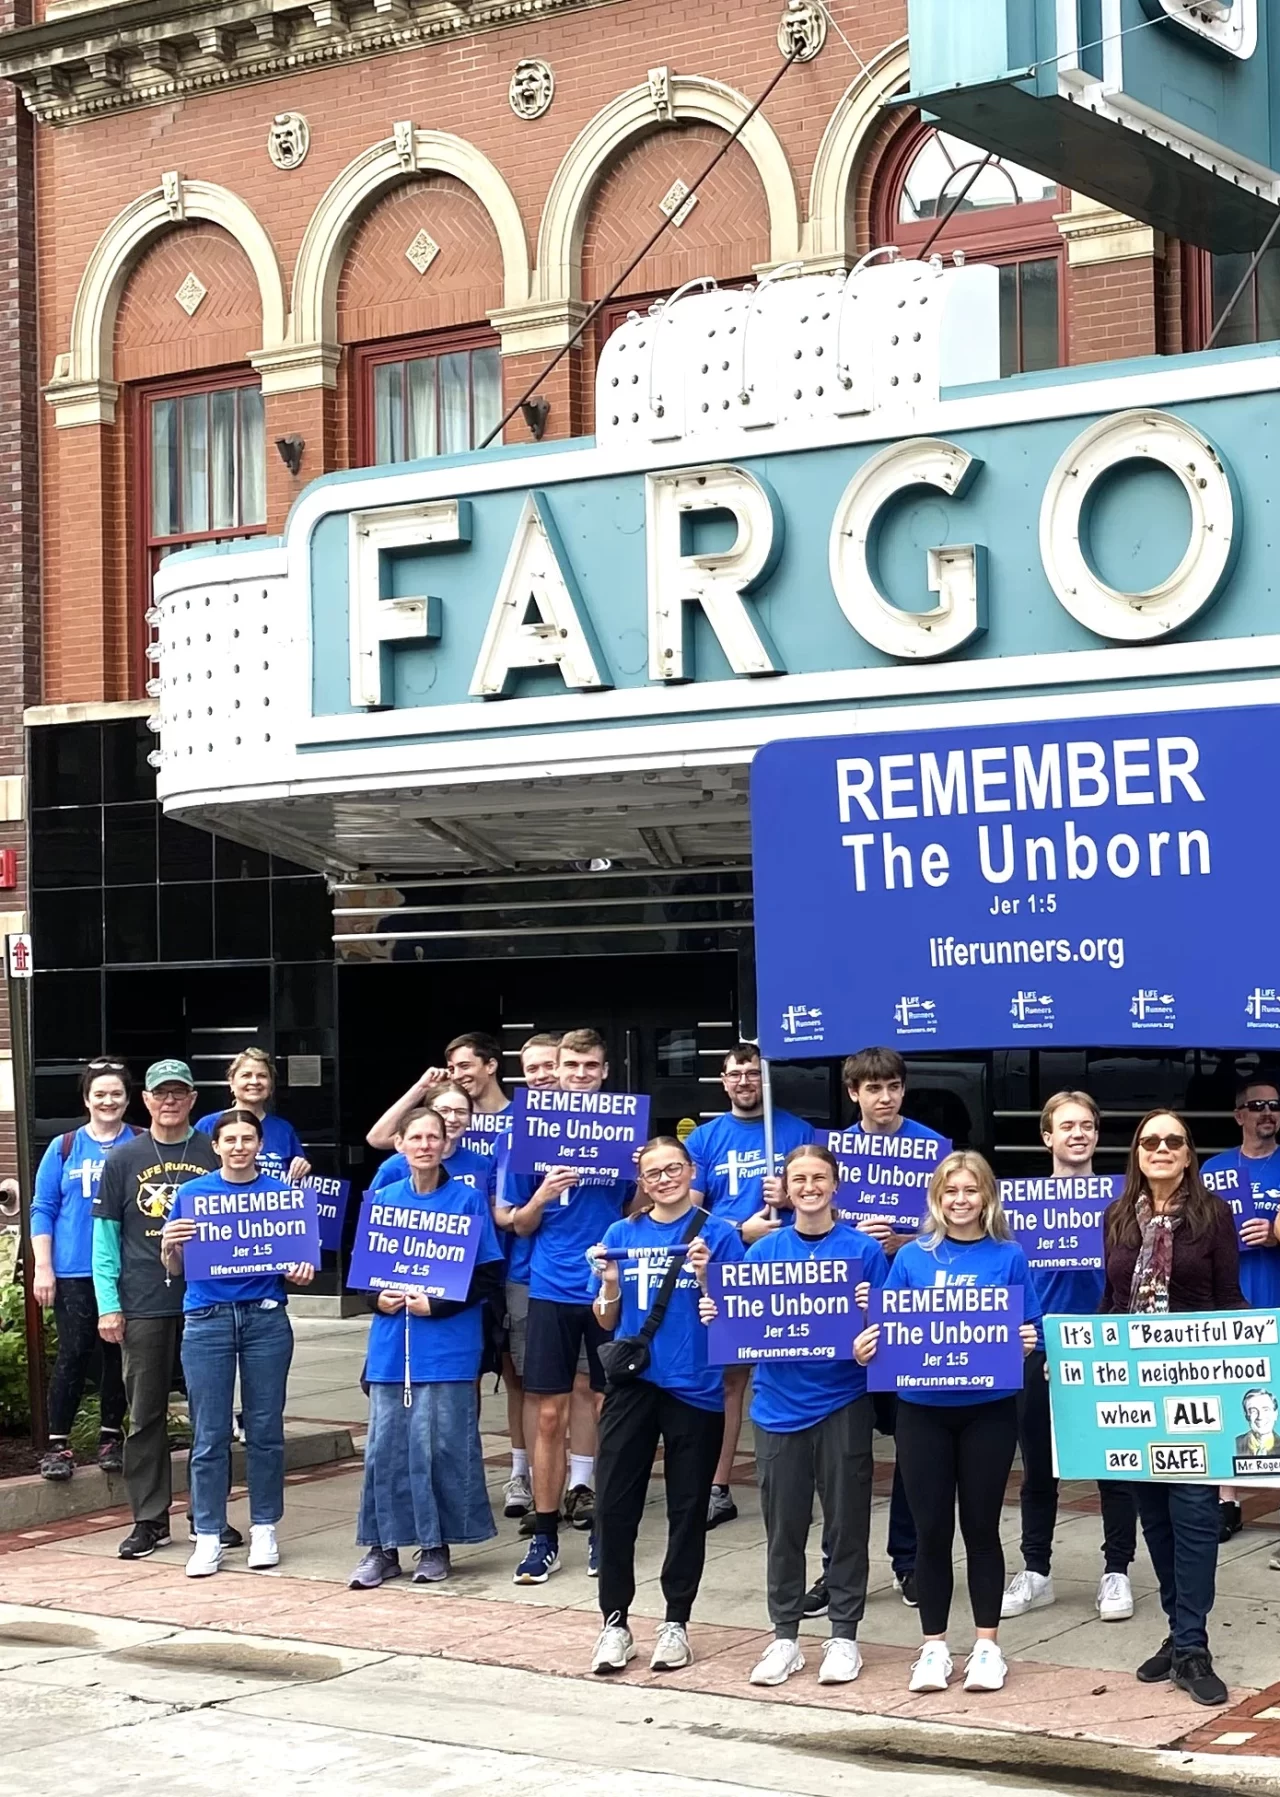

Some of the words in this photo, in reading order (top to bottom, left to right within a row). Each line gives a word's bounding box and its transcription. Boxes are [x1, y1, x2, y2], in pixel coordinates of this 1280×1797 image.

[347, 406, 1244, 709] FARGO
[835, 735, 1206, 823] REMEMBER
[841, 831, 950, 892] The
[978, 820, 1211, 884] Unborn
[989, 896, 1020, 917] Jer
[1027, 893, 1058, 914] 1:5
[929, 936, 1125, 969] liferunners.org
[527, 1090, 636, 1115] REMEMBER
[526, 1117, 561, 1139] The
[566, 1119, 635, 1142] Unborn
[558, 1146, 576, 1158] Jer
[578, 1146, 598, 1158] 1:5
[738, 1150, 761, 1161] LIFE
[827, 1132, 938, 1161] REMEMBER
[136, 1165, 162, 1183] LIFE
[738, 1166, 785, 1177] Runnrs
[837, 1161, 862, 1183] he
[857, 1191, 876, 1205] Jer
[878, 1193, 899, 1206] 1:5
[1000, 1178, 1113, 1201] REMEMBER
[194, 1190, 305, 1216] REMEMBER
[197, 1221, 231, 1242] The
[245, 1218, 306, 1240] Unborn
[370, 1205, 471, 1236] REMEMBER
[1005, 1210, 1037, 1230] The
[1044, 1207, 1104, 1229] Unbor
[232, 1245, 251, 1257] Jer
[253, 1244, 273, 1257] 1:5
[367, 1232, 399, 1255] The
[403, 1235, 466, 1263] Unborn
[1036, 1237, 1055, 1250] Jer
[1058, 1236, 1079, 1248] 1:5
[210, 1261, 297, 1276] liferunners.org
[392, 1261, 410, 1275] Jer
[411, 1263, 430, 1276] 1:5
[721, 1260, 848, 1287] REMEMBER
[946, 1274, 977, 1287] LIFE
[724, 1296, 764, 1318] The
[771, 1295, 849, 1317] Unborn
[882, 1288, 1009, 1313] REMEMBER
[763, 1325, 784, 1338] Jer
[787, 1324, 810, 1337] 1:5
[883, 1322, 923, 1345] The
[930, 1322, 1009, 1344] Unborn
[1064, 1325, 1092, 1345] It's
[1106, 1327, 1117, 1341] a
[737, 1344, 836, 1359] liferunners.org
[922, 1352, 943, 1366] Jer
[946, 1352, 969, 1366] 1:5
[896, 1374, 994, 1388] liferunners.org
[1064, 1365, 1082, 1382] in
[1096, 1364, 1127, 1382] the
[1141, 1359, 1266, 1384] neighborhood
[1101, 1406, 1152, 1424] when
[1174, 1402, 1216, 1425] ALL
[1109, 1452, 1139, 1467] are
[1155, 1448, 1204, 1470] SAFE.
